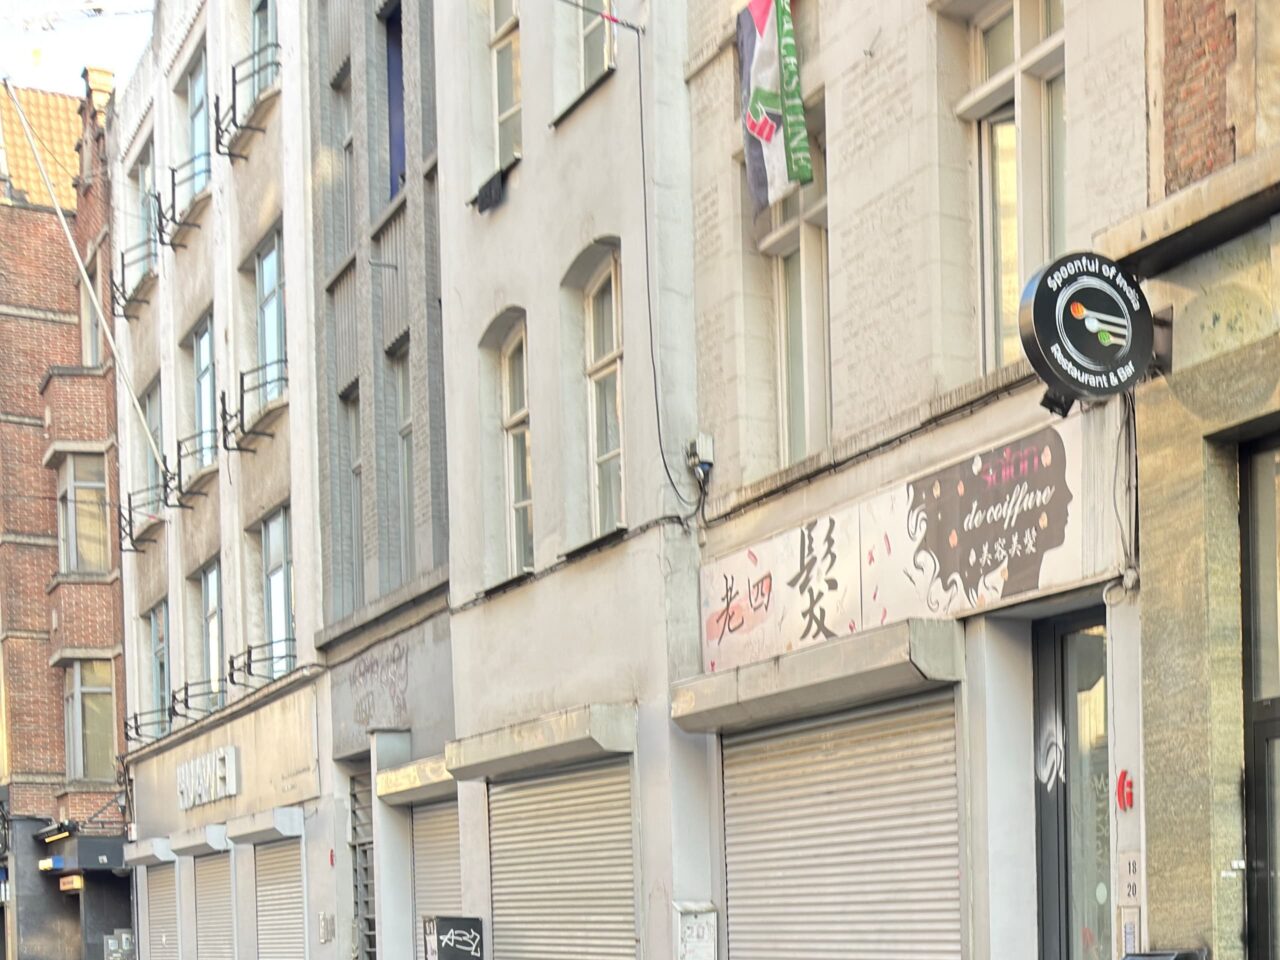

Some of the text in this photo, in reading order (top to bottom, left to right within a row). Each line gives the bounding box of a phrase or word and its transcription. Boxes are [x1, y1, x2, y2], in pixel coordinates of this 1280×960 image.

[1047, 256, 1140, 311] Spoonful of India
[1051, 343, 1136, 388] Restaurant & Bar
[987, 481, 1056, 531] coiffure
[1126, 883, 1138, 897] 20
[1127, 861, 1138, 875] 18
